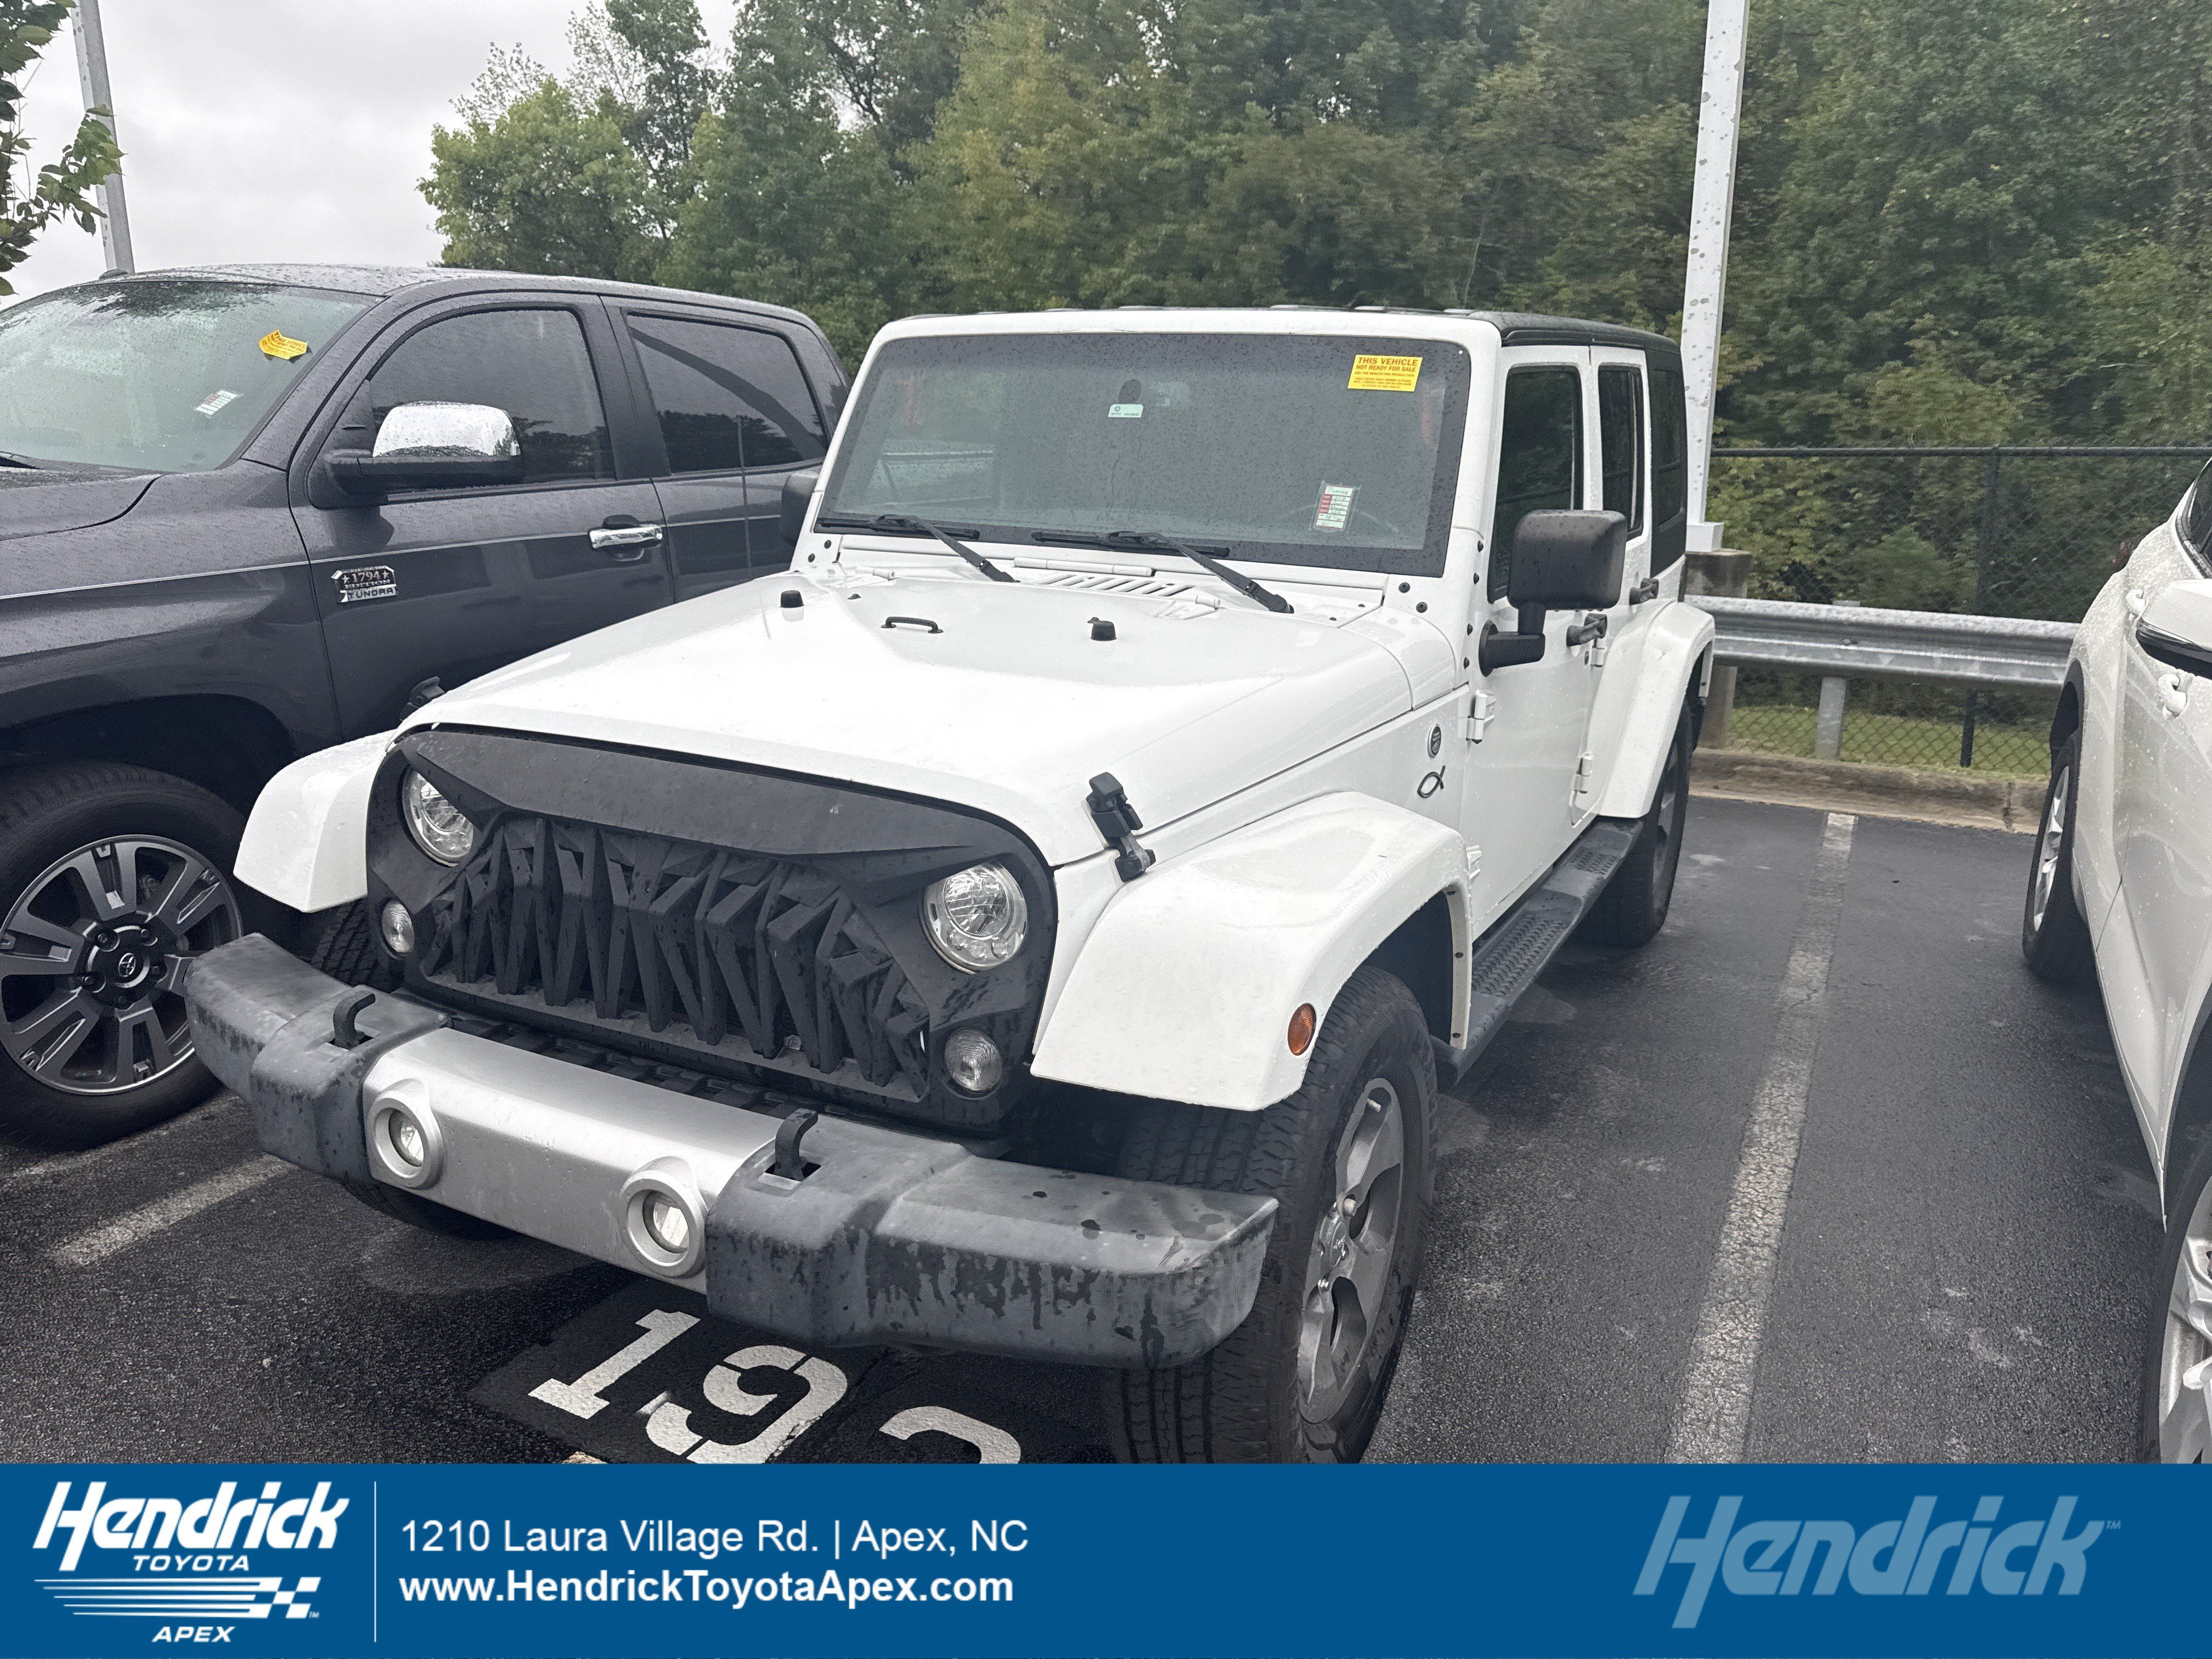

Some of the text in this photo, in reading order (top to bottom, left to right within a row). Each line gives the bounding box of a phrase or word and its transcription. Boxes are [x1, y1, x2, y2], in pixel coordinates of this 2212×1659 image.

[1381, 358, 1418, 366] VEHICLE
[352, 571, 380, 583] 1794
[348, 588, 393, 599] TUNDRA
